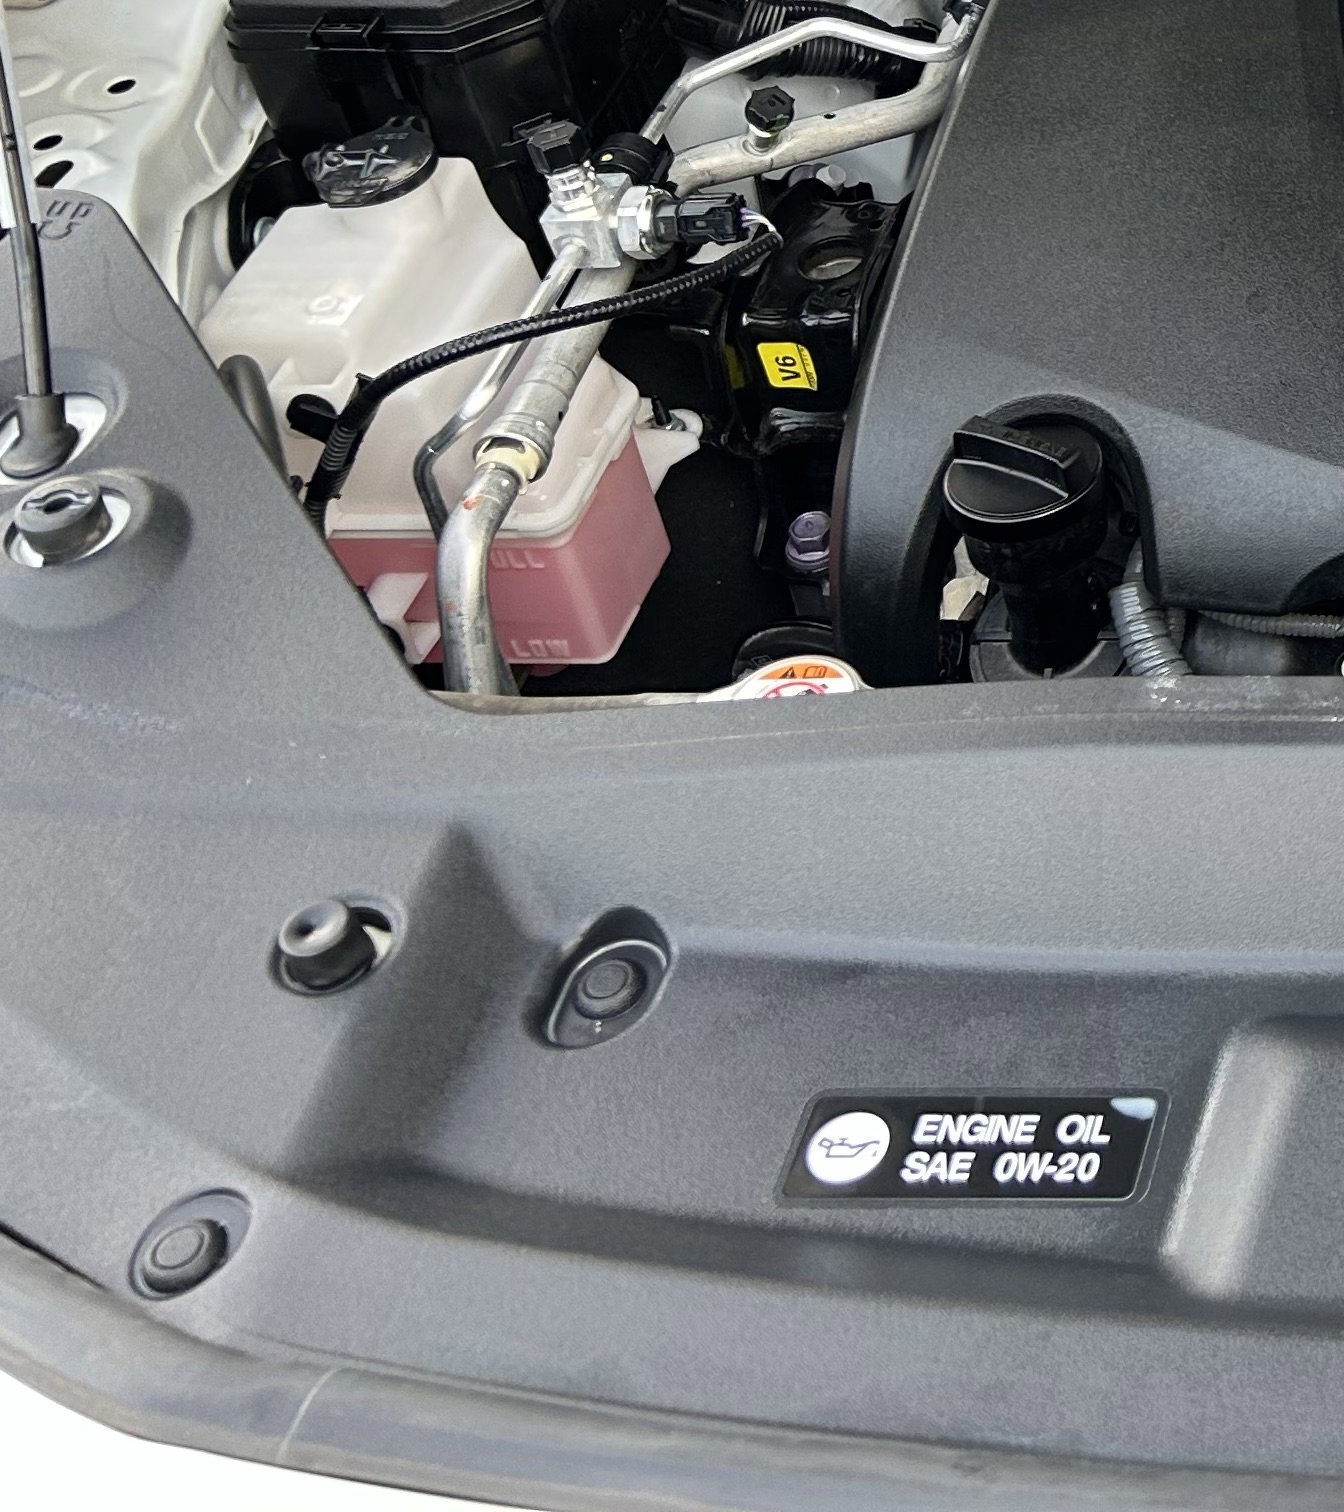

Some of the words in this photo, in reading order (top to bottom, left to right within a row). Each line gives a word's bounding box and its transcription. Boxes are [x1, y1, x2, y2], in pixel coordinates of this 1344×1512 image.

[774, 355, 801, 381] V6
[490, 549, 545, 569] ULL
[511, 639, 571, 658] LOW
[912, 1114, 1041, 1145] ENGINE
[1055, 1114, 1111, 1145] OIL
[900, 1151, 977, 1184] SAE
[993, 1152, 1101, 1184] 0W-20
